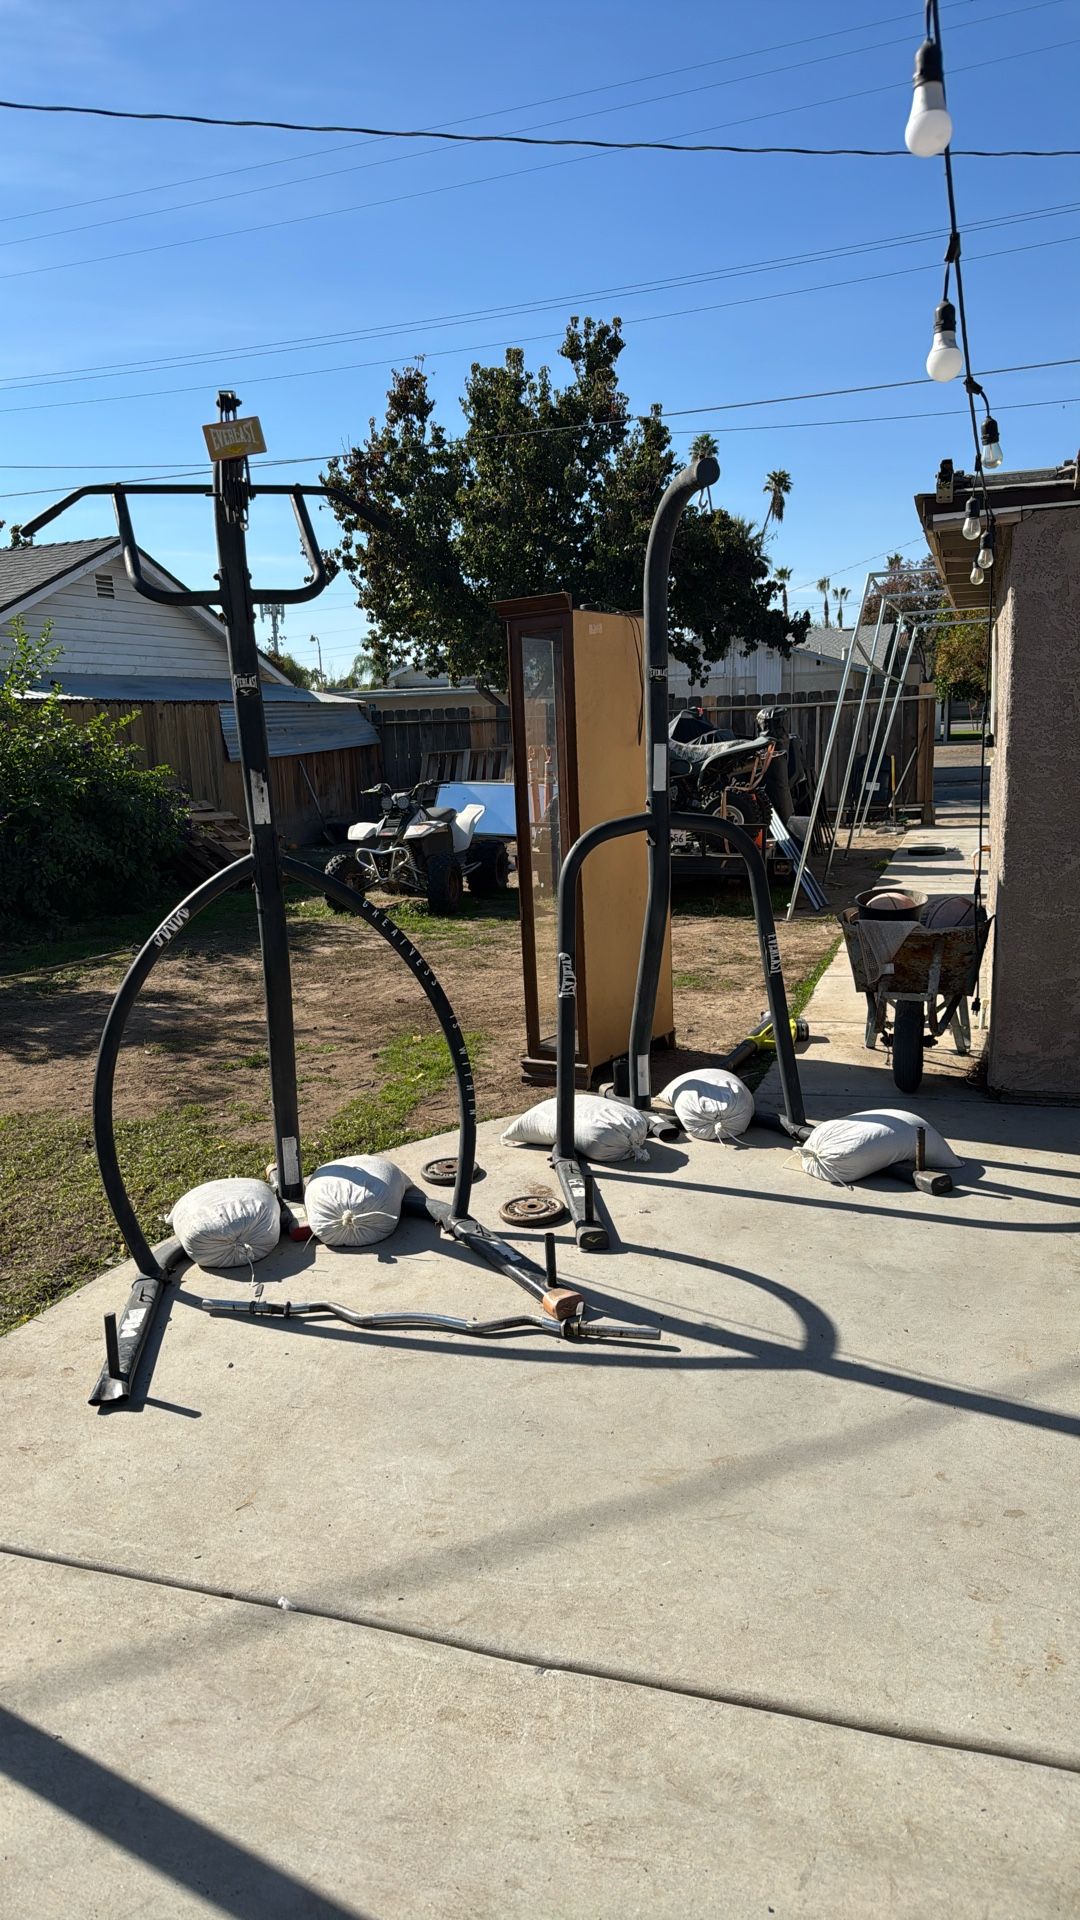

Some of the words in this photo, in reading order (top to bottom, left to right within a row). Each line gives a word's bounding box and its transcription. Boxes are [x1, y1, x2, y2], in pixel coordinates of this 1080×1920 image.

[208, 421, 257, 451] EVERLAST
[767, 932, 782, 974] EVERLAST
[559, 952, 577, 999] EVERLAST
[362, 900, 437, 986] GREATNESS
[450, 1015, 460, 1029] IS
[459, 1046, 477, 1116] WITHIN
